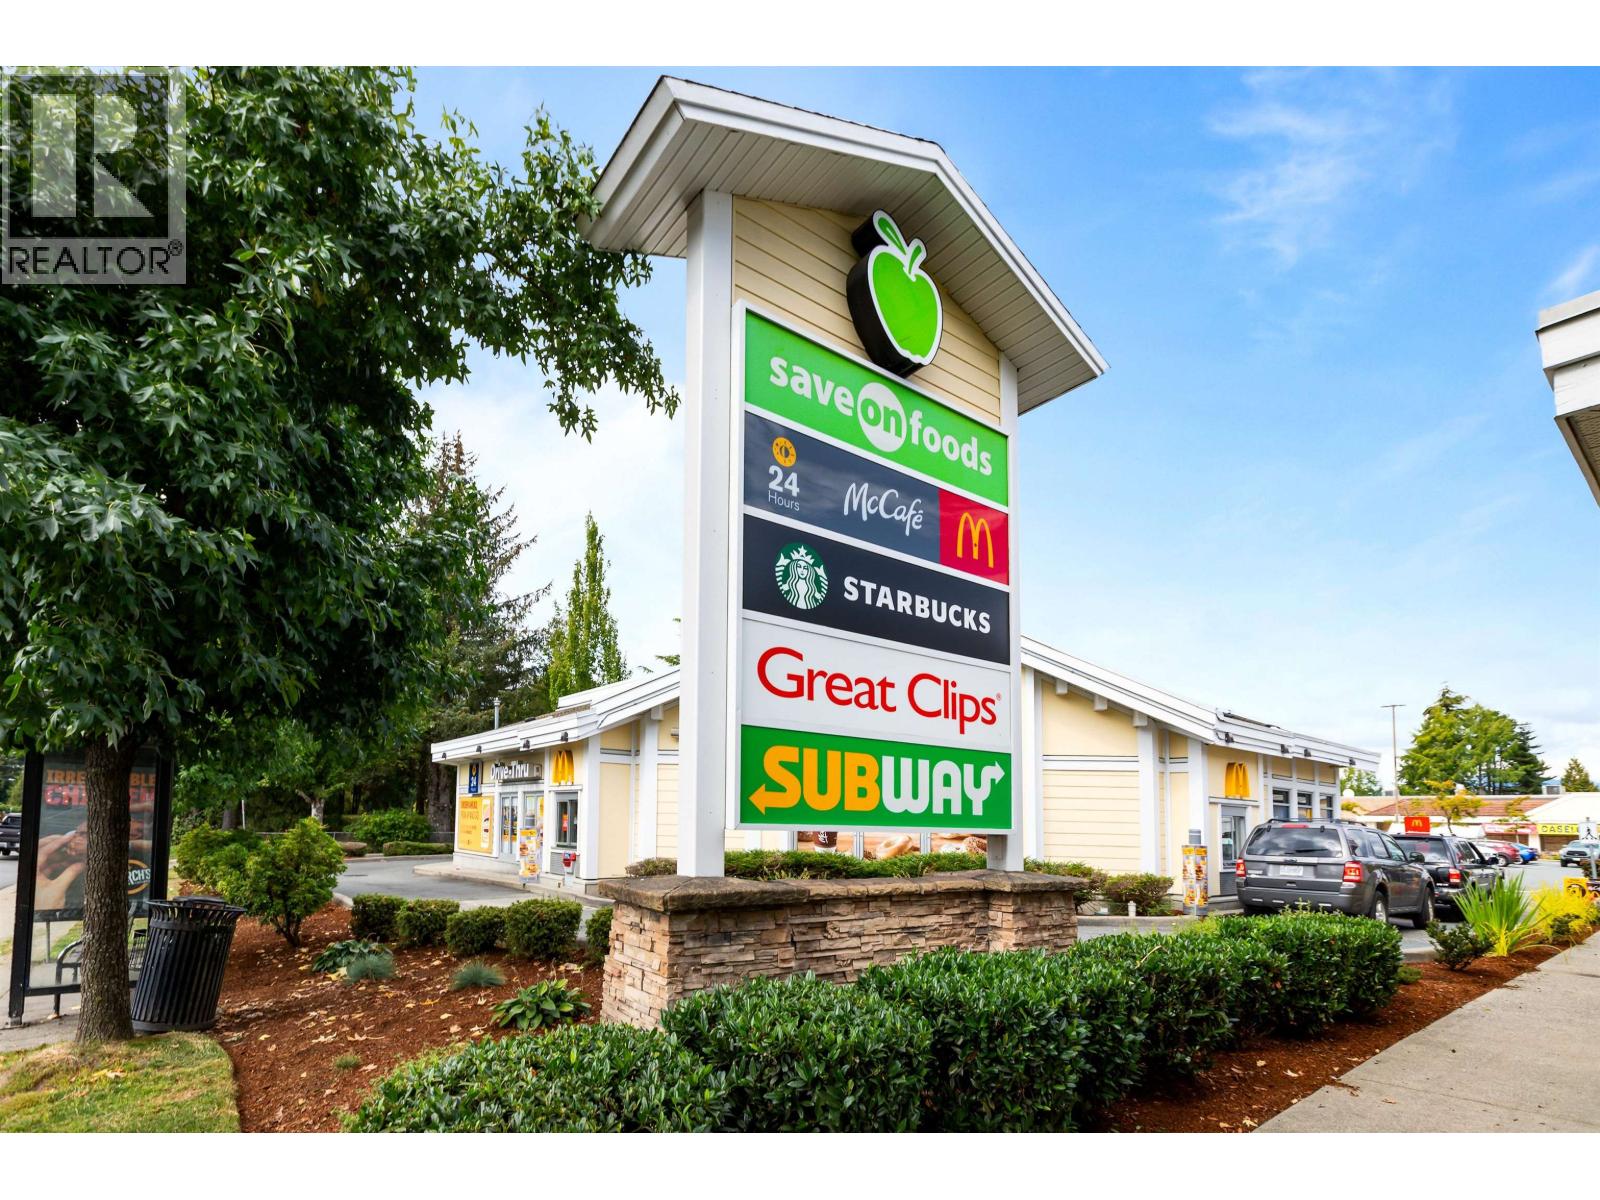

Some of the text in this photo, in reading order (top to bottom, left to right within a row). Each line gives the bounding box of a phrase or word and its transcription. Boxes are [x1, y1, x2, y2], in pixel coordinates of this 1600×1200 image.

[769, 356, 993, 476] save on foods
[767, 465, 800, 496] 24
[767, 490, 801, 512] Hours
[843, 482, 925, 536] McCafé
[843, 575, 991, 634] STARBUCKS
[756, 646, 898, 713] Great
[748, 744, 1006, 816] SUBWAY
